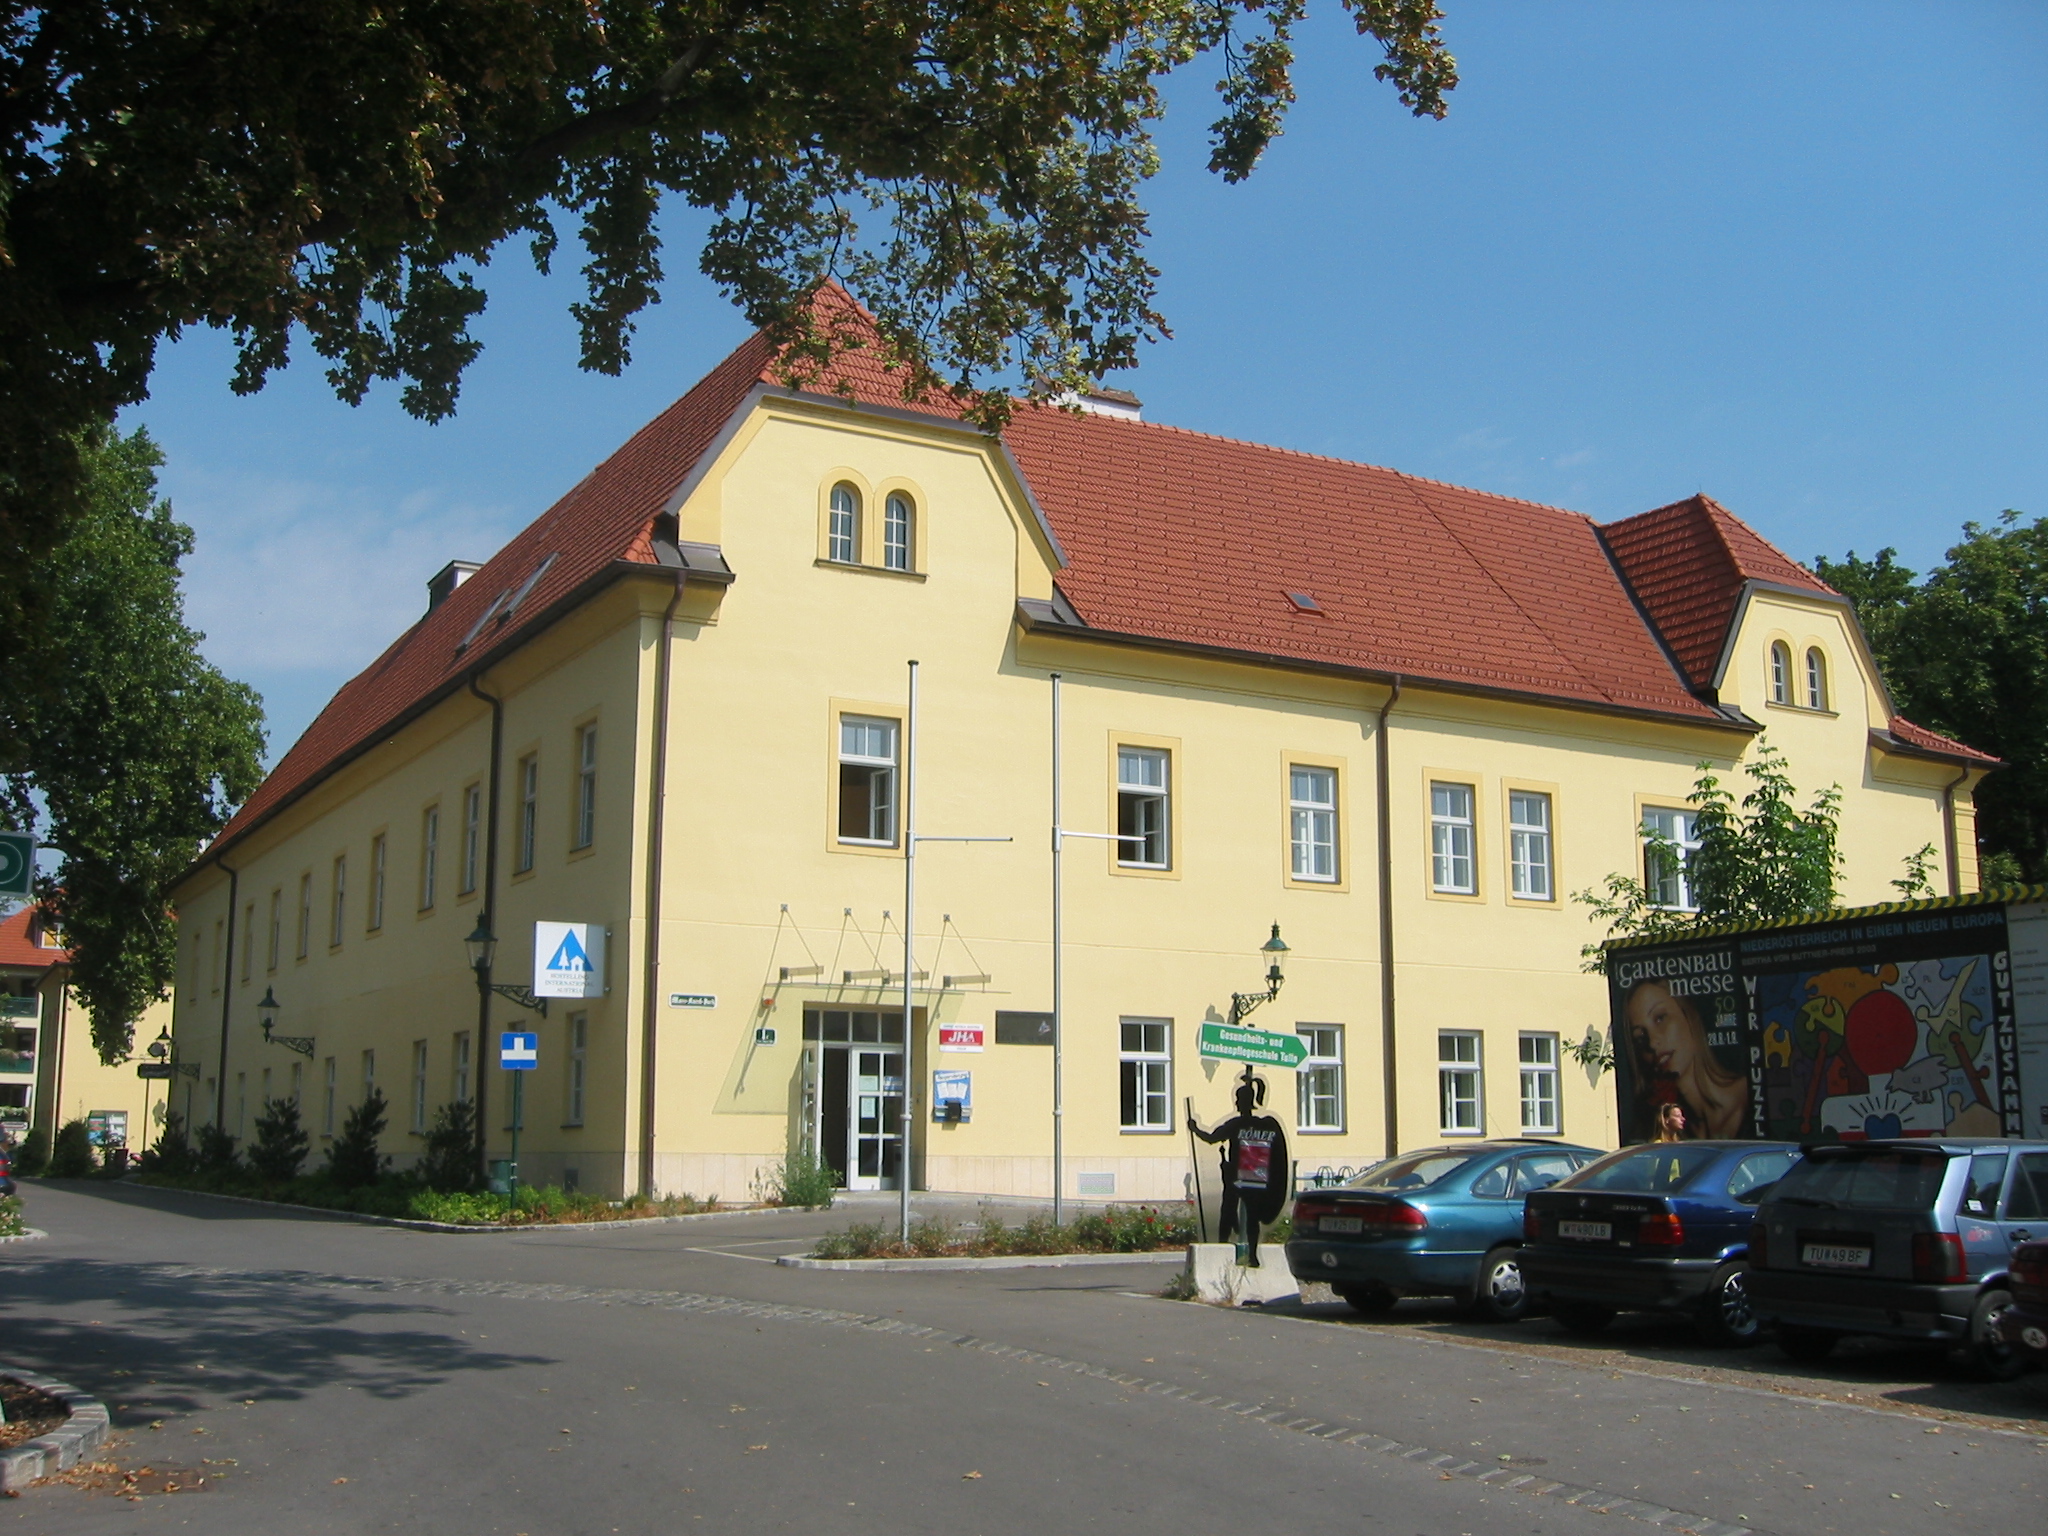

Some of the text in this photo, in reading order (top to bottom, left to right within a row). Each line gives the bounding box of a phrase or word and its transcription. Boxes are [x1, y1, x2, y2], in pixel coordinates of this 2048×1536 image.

[1740, 929, 1847, 952] NIEDERÖSTERREICH
[1851, 927, 1862, 940] IN
[1866, 923, 1903, 938] EINEM
[1907, 917, 1948, 934] NEUEN
[1951, 911, 2004, 929] EUROPA
[1668, 973, 1735, 997] messe
[1993, 950, 2010, 1008] GUT
[1715, 995, 1735, 1016] 50
[1742, 975, 1758, 1031] WIR
[948, 1031, 975, 1043] JHA
[1269, 1037, 1284, 1048] und
[1202, 1040, 1279, 1061] Krankenpflegeschule
